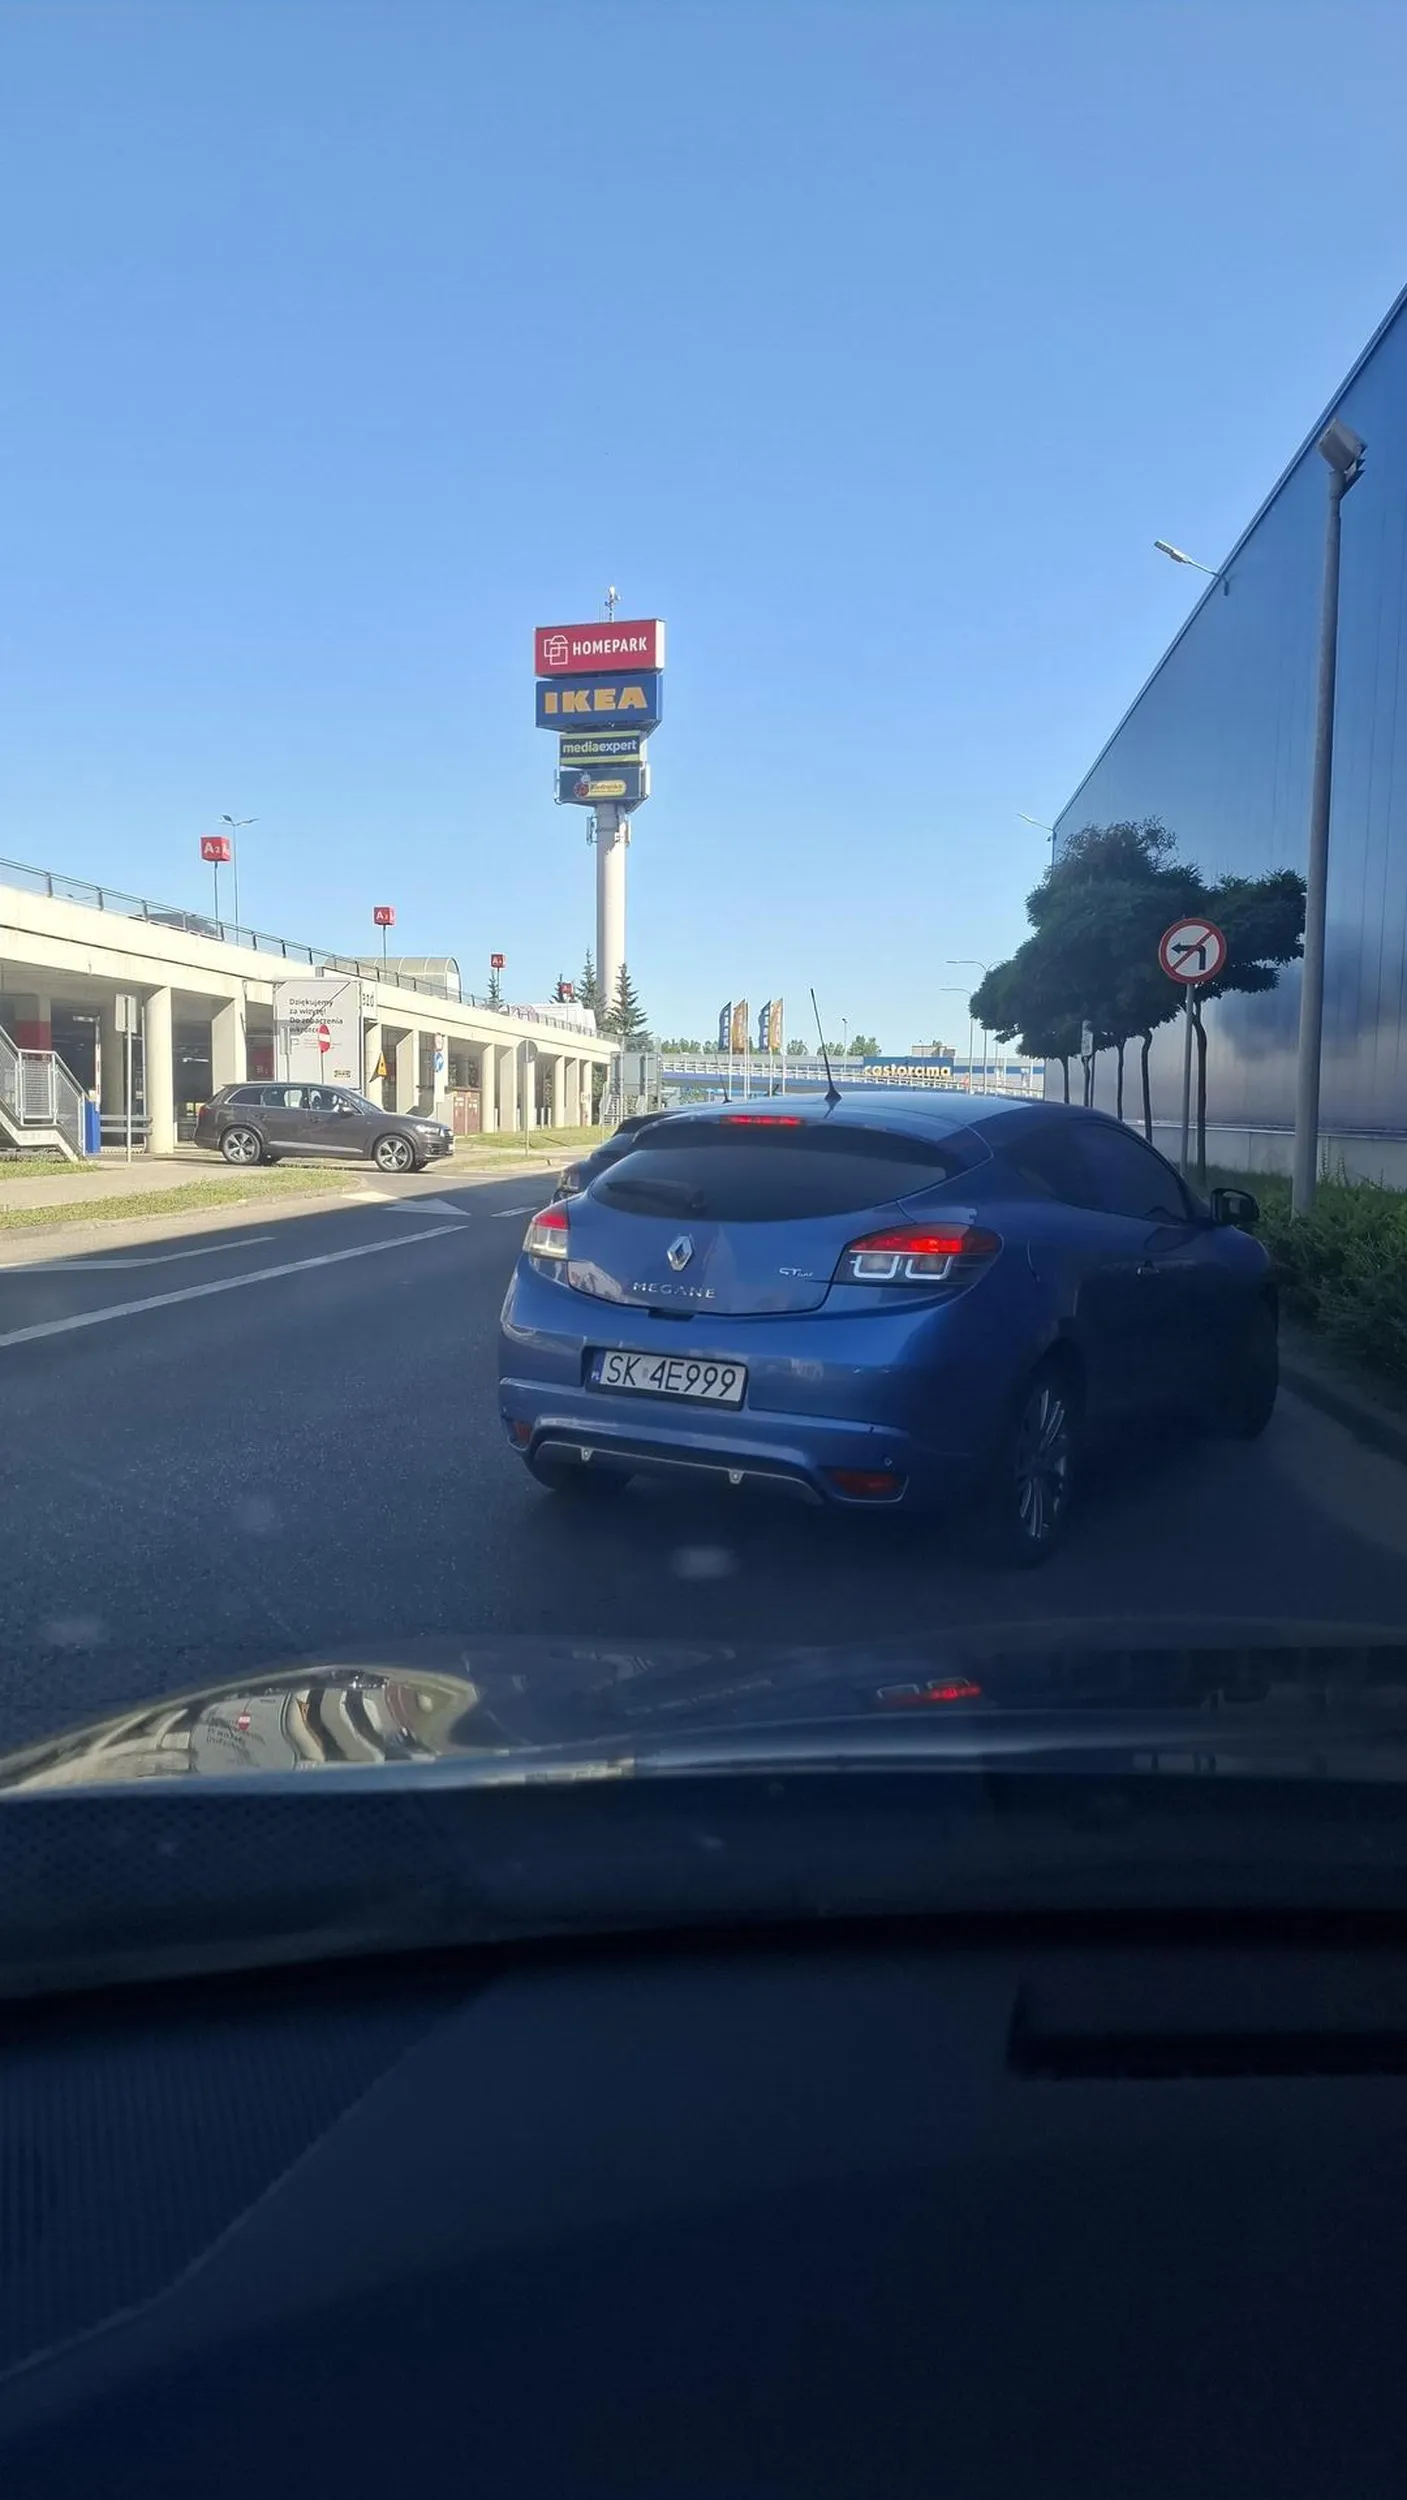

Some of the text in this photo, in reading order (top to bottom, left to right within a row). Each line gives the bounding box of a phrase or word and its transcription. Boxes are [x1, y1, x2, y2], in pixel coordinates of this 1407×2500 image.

[573, 637, 647, 655] HOMEPARK
[545, 687, 647, 714] IKEA
[563, 740, 637, 753] mediaexpert
[289, 999, 334, 1007] Dziękujemy
[301, 1016, 344, 1025] zobaczenia
[864, 1063, 952, 1077] castorama
[633, 1282, 716, 1298] MEGANE
[606, 1355, 641, 1386] SK
[649, 1359, 736, 1397] 4E999
